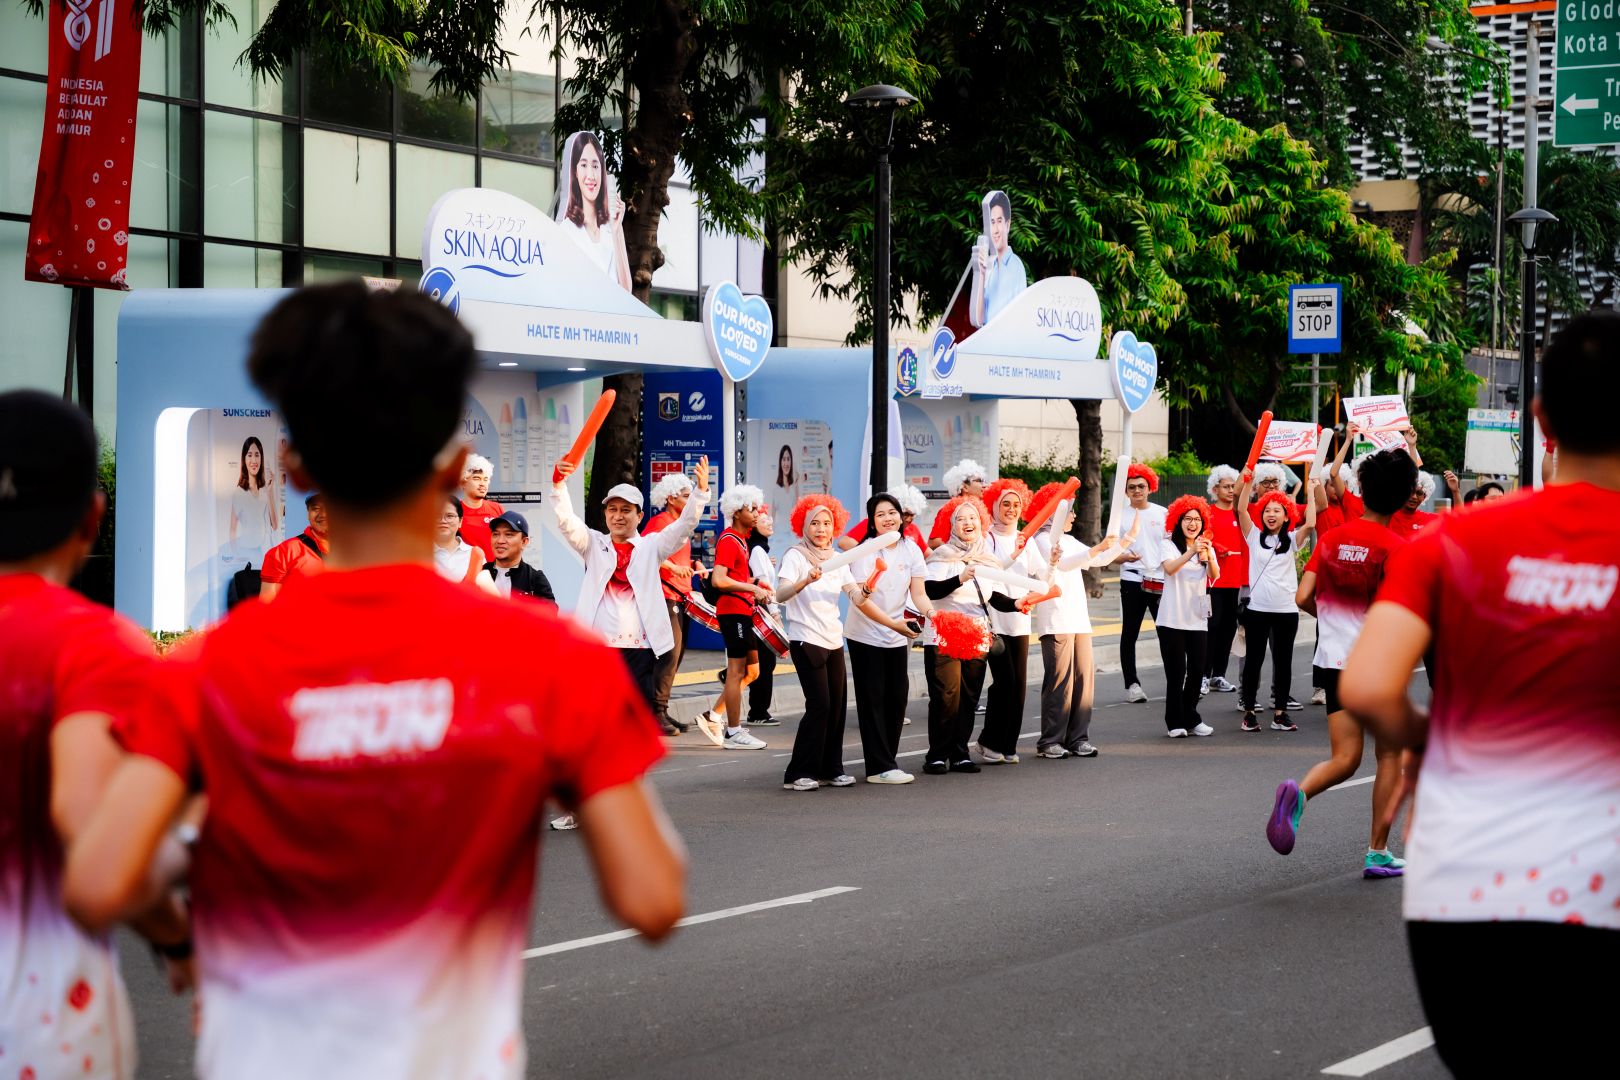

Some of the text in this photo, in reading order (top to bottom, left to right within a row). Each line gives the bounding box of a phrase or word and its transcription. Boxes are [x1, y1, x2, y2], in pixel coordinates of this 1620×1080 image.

[1565, 0, 1620, 21] Glod
[1564, 33, 1608, 54] Kota
[1603, 111, 1620, 131] Pe
[443, 228, 545, 267] SKIN AQUA
[715, 300, 769, 339] OUR MOST
[1036, 306, 1096, 333] SKIN AQUA
[1298, 314, 1332, 332] STOP
[527, 323, 639, 345] HALTE MH THAMRIN 1
[720, 322, 758, 353] LOVED
[1119, 347, 1154, 377] OUR MOST
[988, 365, 1061, 381] HALTE MH THAMRIN 2
[223, 408, 271, 418] SUNSCREEN
[768, 422, 798, 430] SUNSCREEN
[663, 439, 706, 447] MH Thamrin 2
[1342, 550, 1368, 562] RUN
